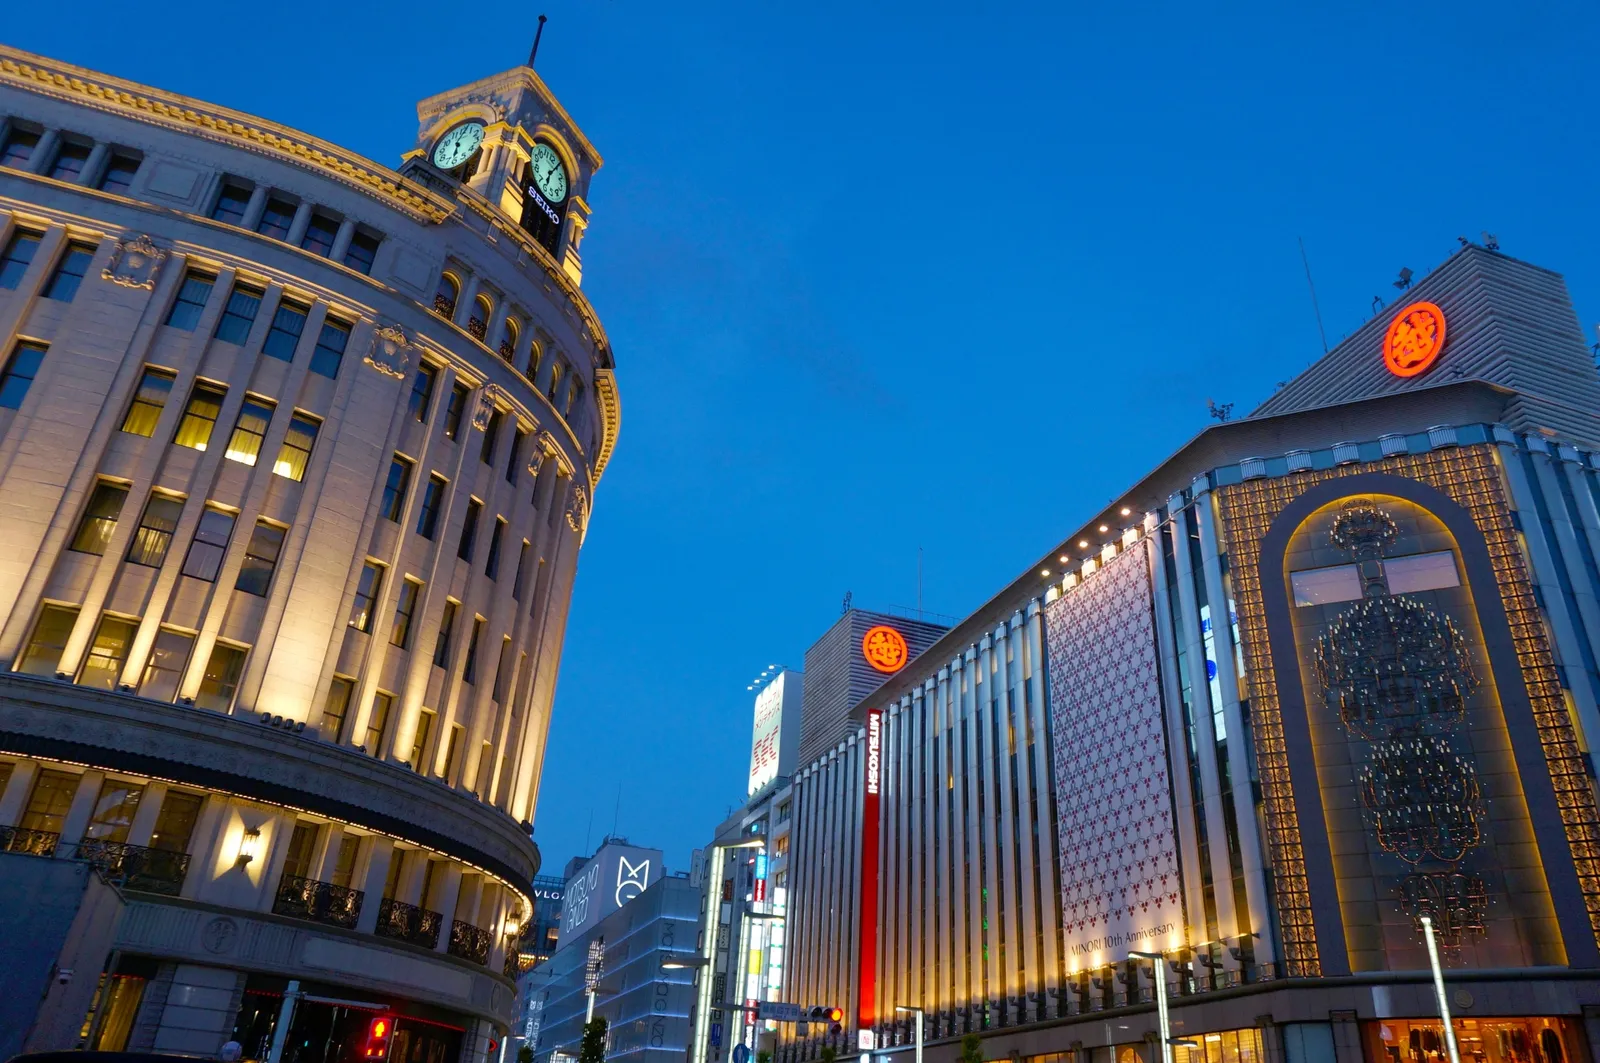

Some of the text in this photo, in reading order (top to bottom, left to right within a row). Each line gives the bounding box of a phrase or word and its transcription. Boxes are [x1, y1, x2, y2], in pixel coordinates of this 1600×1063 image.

[528, 186, 560, 225] SEIKO
[868, 714, 880, 794] MITSUKOSHI
[1071, 922, 1176, 956] MINORI 10th Anniversary
